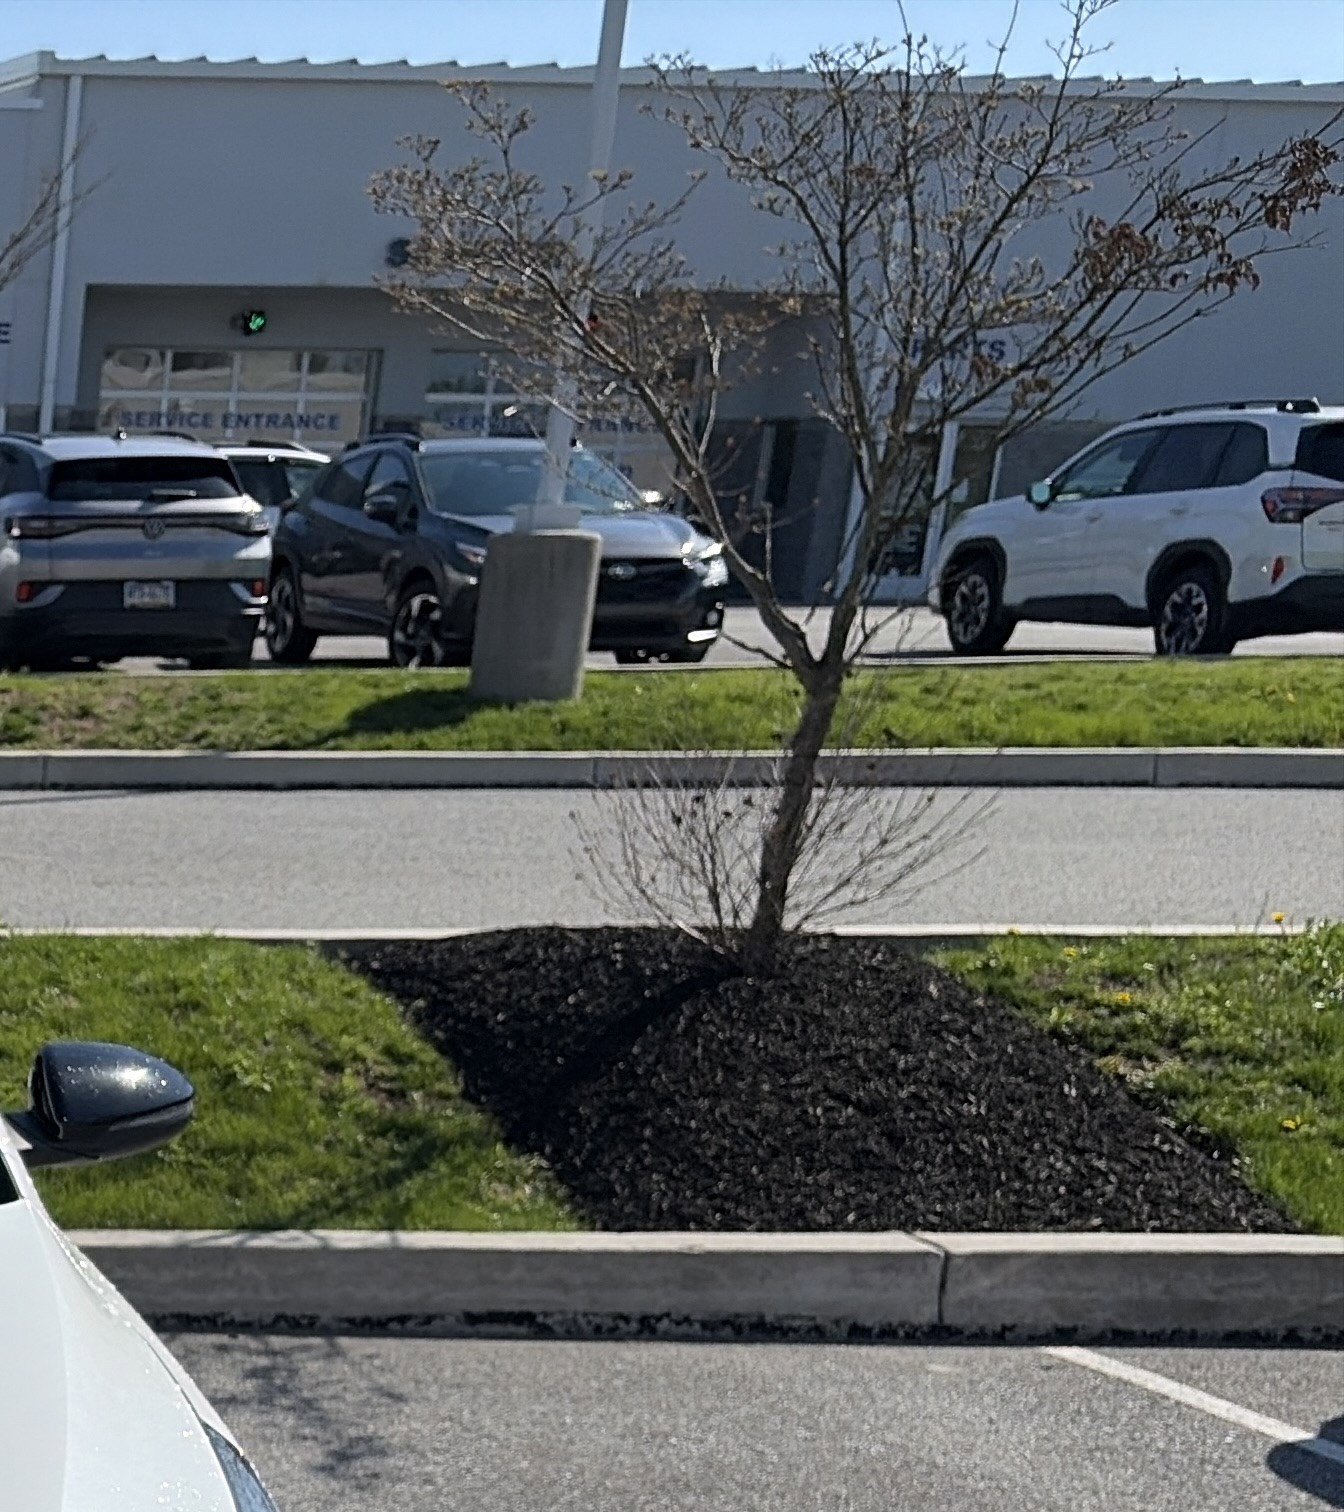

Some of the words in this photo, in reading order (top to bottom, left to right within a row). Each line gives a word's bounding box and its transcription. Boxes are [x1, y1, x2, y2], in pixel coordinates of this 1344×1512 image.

[910, 337, 1007, 362] PRTS
[119, 411, 212, 428] SERVICE
[221, 412, 342, 431] ENTRANCE
